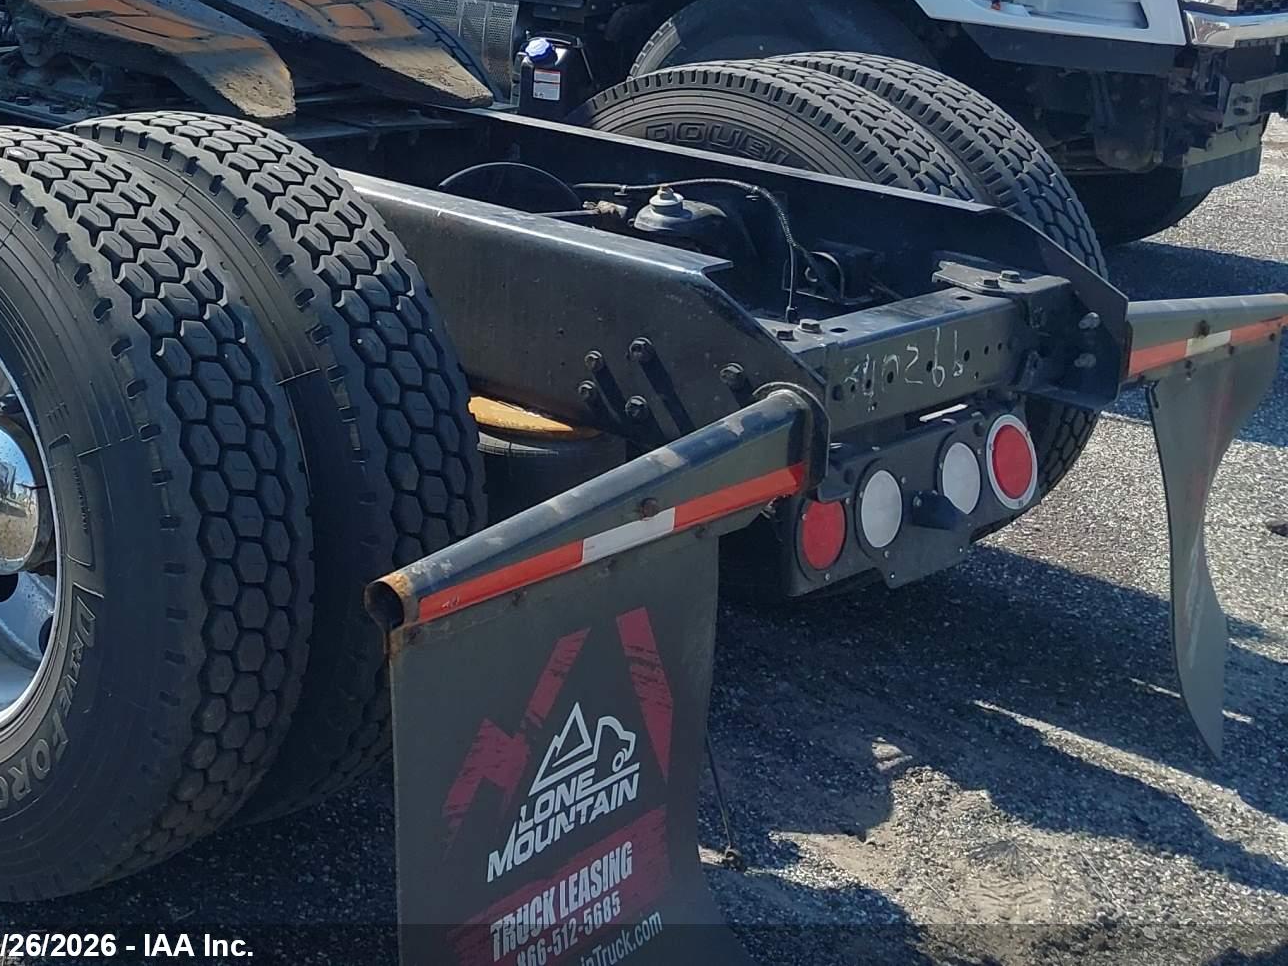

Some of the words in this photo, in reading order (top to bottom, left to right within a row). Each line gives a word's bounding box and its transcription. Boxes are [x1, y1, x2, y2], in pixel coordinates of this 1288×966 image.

[486, 773, 641, 884] MOUNTAIN
[517, 767, 597, 831] LONE
[490, 884, 557, 963] TRUCK
[559, 840, 634, 921] LEASING
